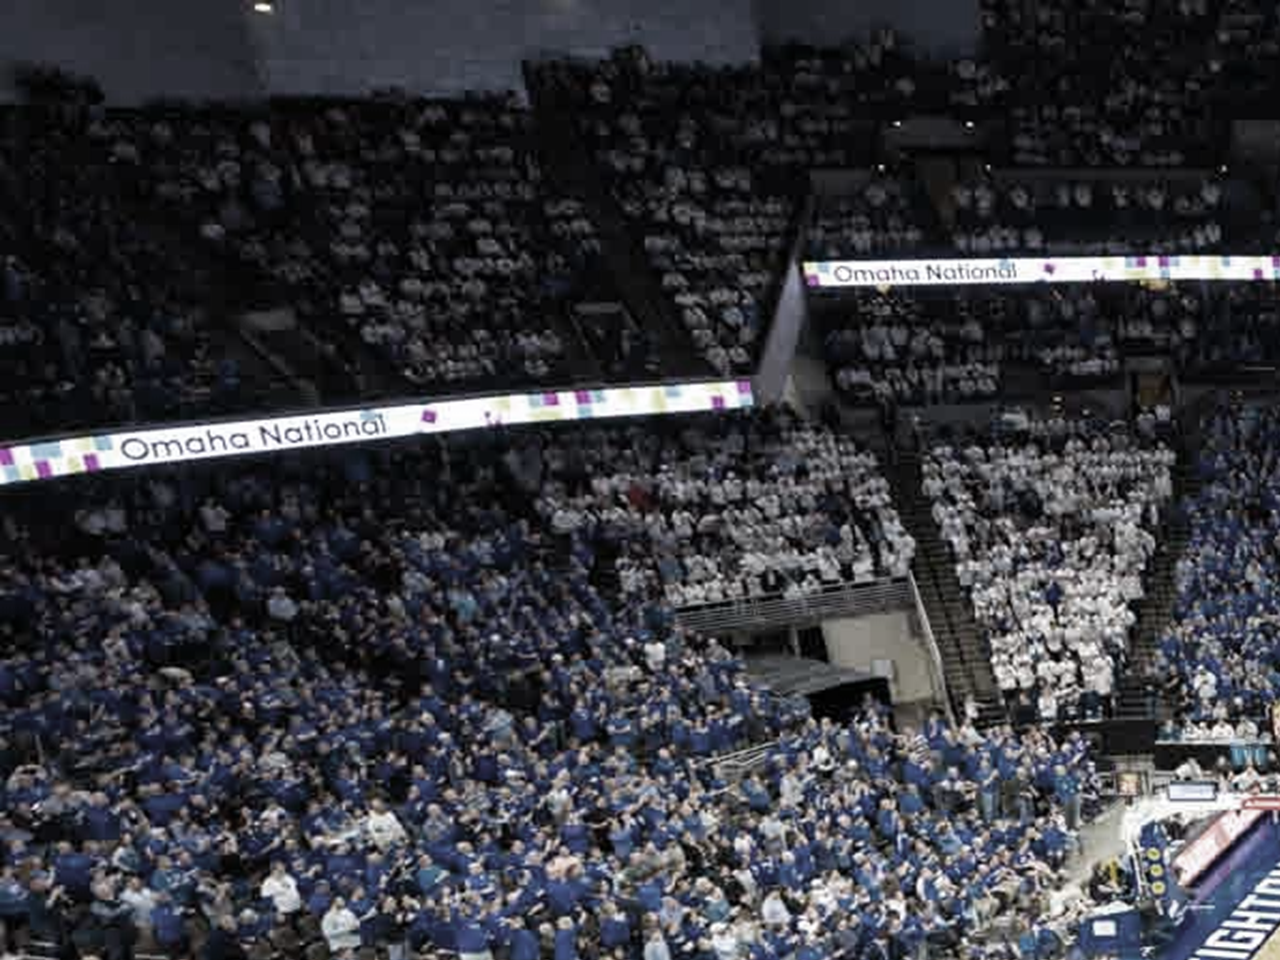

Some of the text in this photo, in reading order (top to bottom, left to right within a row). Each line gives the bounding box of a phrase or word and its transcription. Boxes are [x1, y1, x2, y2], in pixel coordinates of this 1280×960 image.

[833, 261, 1018, 282] Omaha National
[120, 413, 388, 461] Omaha National
